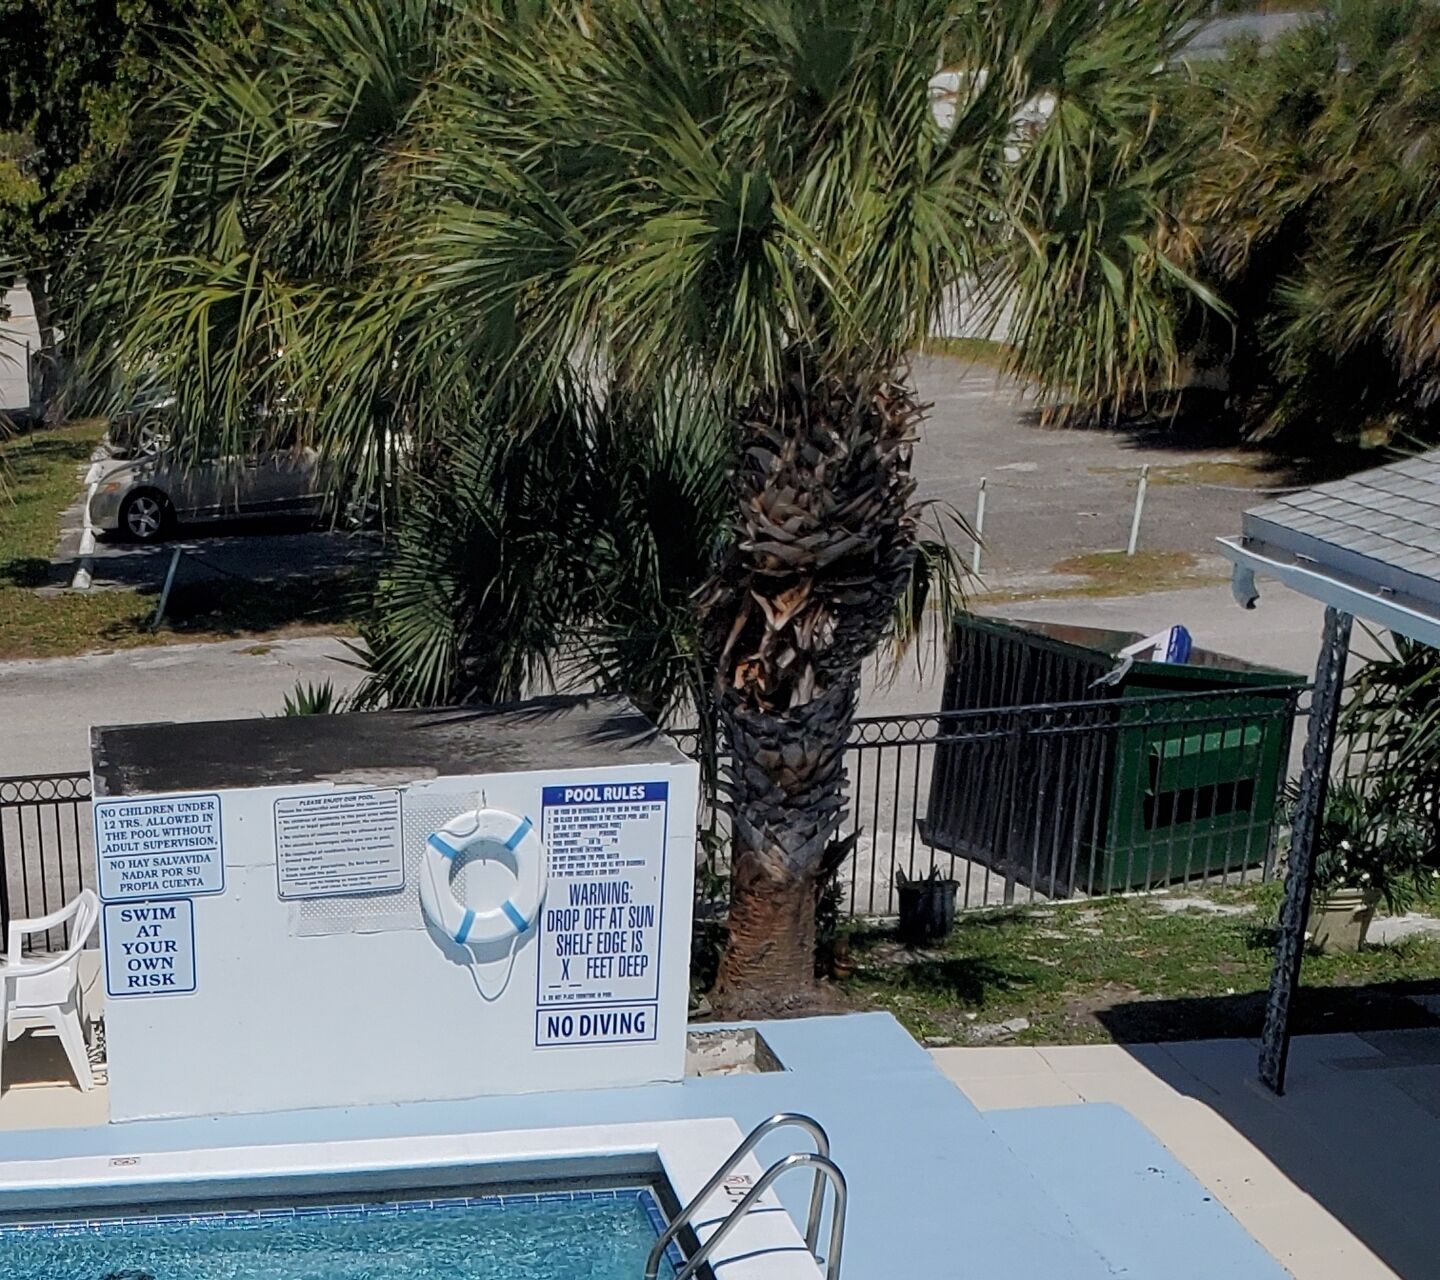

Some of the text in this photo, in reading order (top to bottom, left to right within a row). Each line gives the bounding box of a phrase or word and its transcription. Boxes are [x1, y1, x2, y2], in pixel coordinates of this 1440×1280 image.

[565, 785, 645, 802] POOL RULES
[101, 802, 215, 818] NO CHILDREN UNDER
[104, 821, 116, 830] 12
[146, 815, 199, 827] ALLOWED
[203, 813, 214, 822] IN
[106, 825, 212, 841] THE POOL WITHOUT
[105, 842, 140, 853] ADULT
[110, 854, 211, 870] NO HAY SALVAVIDA
[122, 866, 200, 880] NADAR POR SU
[120, 878, 204, 892] PROPIA CUENTA
[569, 881, 633, 906] WARNING:
[121, 907, 176, 922] SWIM
[547, 905, 654, 932] DROP OFF AT SUN
[136, 925, 162, 938] AT
[122, 940, 178, 955] YOUR
[556, 930, 643, 956] SHELF EDGE IS
[128, 957, 174, 971] OWN
[587, 957, 614, 979] FEET
[618, 955, 648, 977] DEEP
[128, 973, 176, 987] RISK
[548, 1012, 645, 1038] NO DIVING
